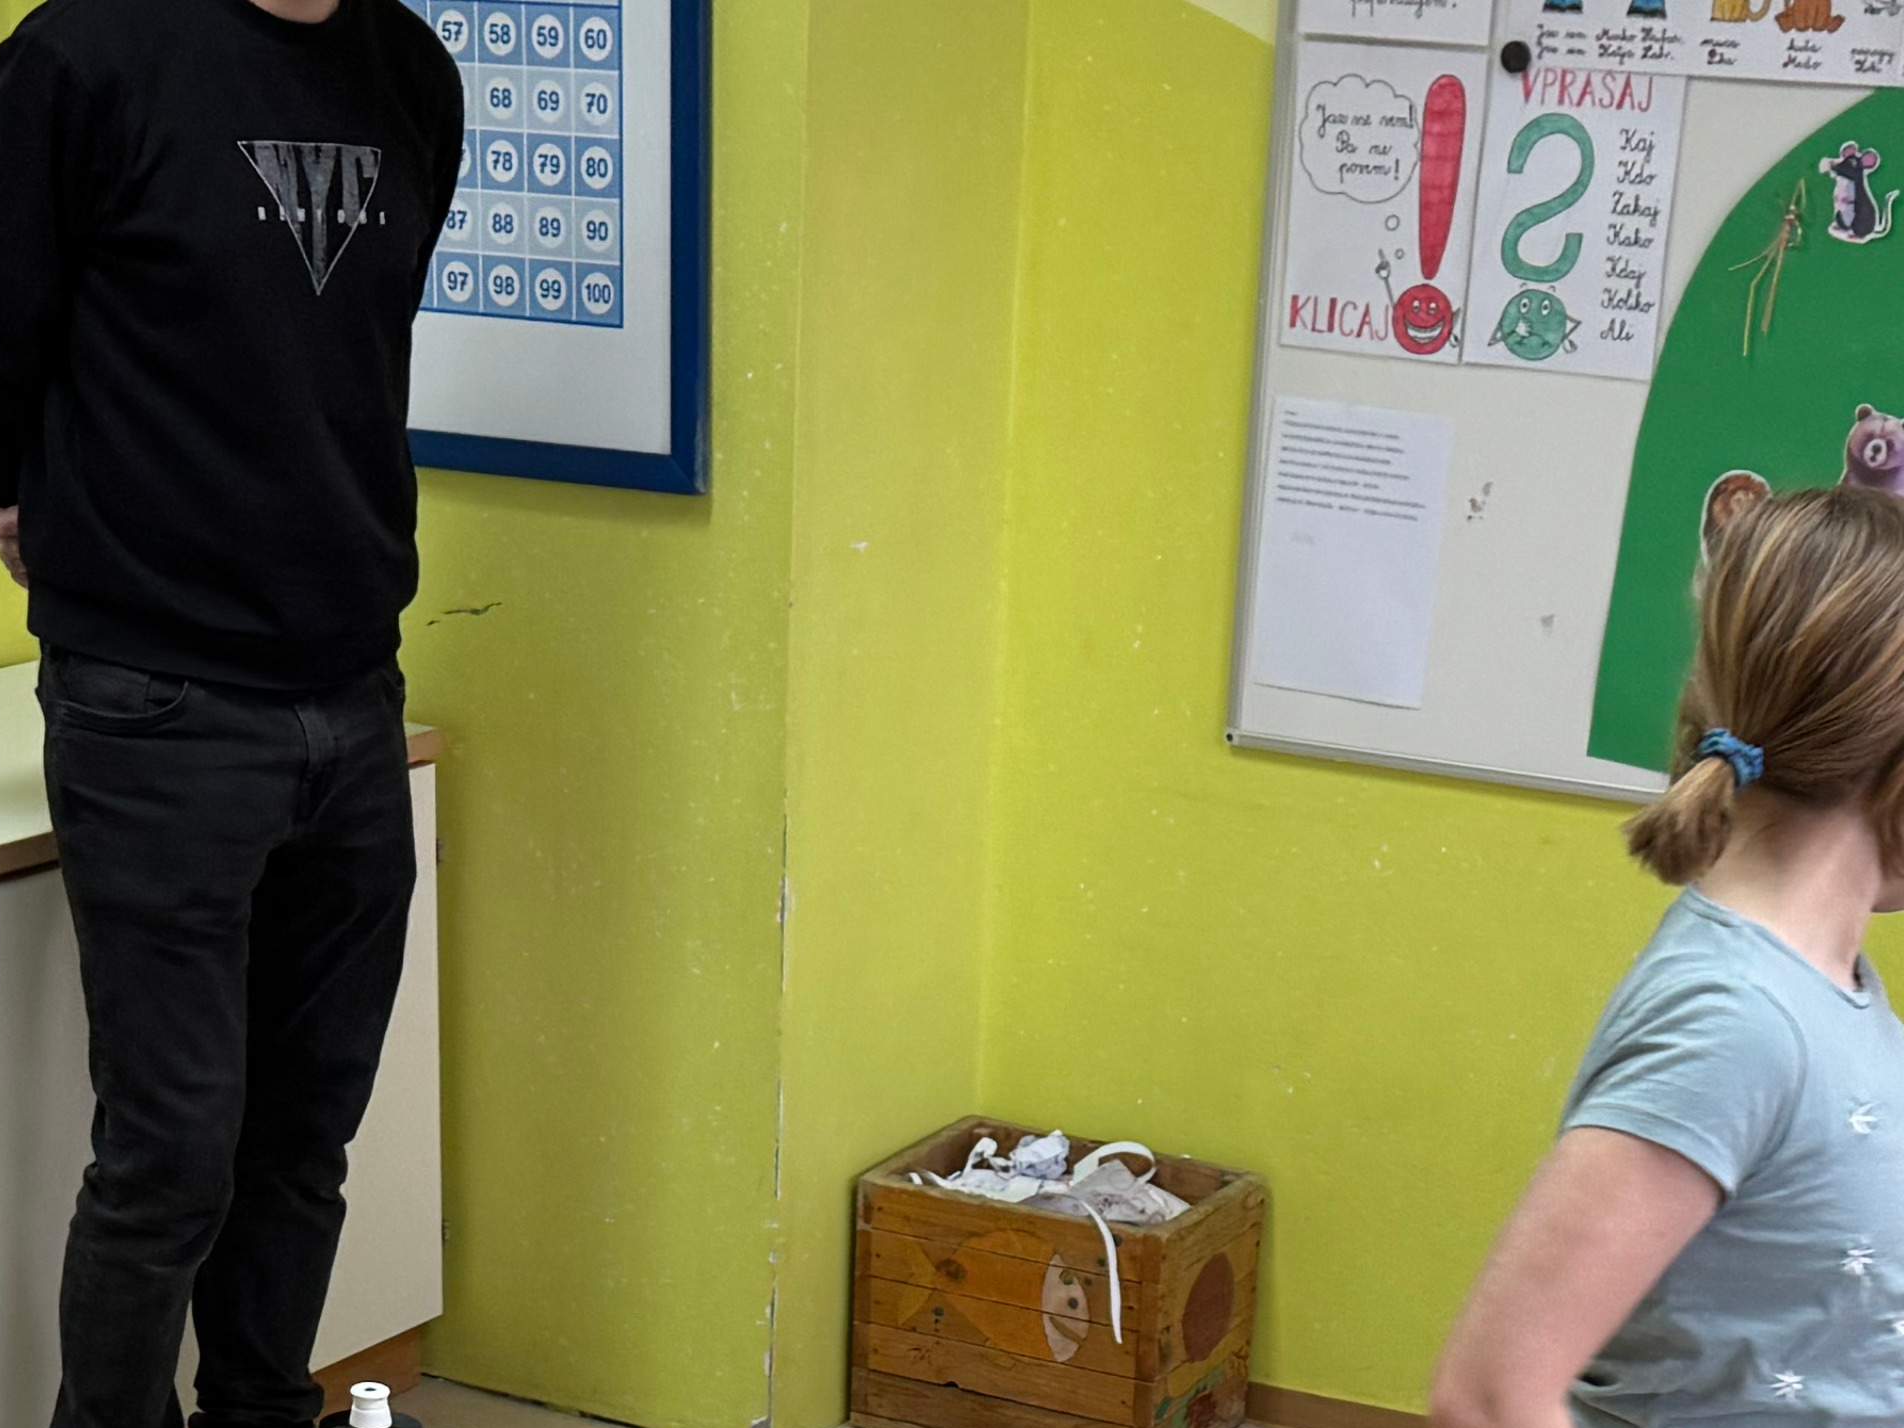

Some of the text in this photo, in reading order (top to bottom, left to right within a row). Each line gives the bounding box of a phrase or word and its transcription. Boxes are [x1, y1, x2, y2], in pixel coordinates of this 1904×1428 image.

[442, 20, 607, 50] 57 58 59 60
[490, 87, 608, 115] 68 69 70
[1619, 127, 1656, 164] Kaj
[491, 150, 608, 178] 78 79 80
[1617, 160, 1658, 185] Kdo
[1610, 190, 1661, 227] Zakaj
[446, 209, 609, 242] 87 88 89 90
[1606, 223, 1654, 250] Kako
[447, 271, 611, 305] 97 98 99 100
[1288, 294, 1390, 341] KLICAJ
